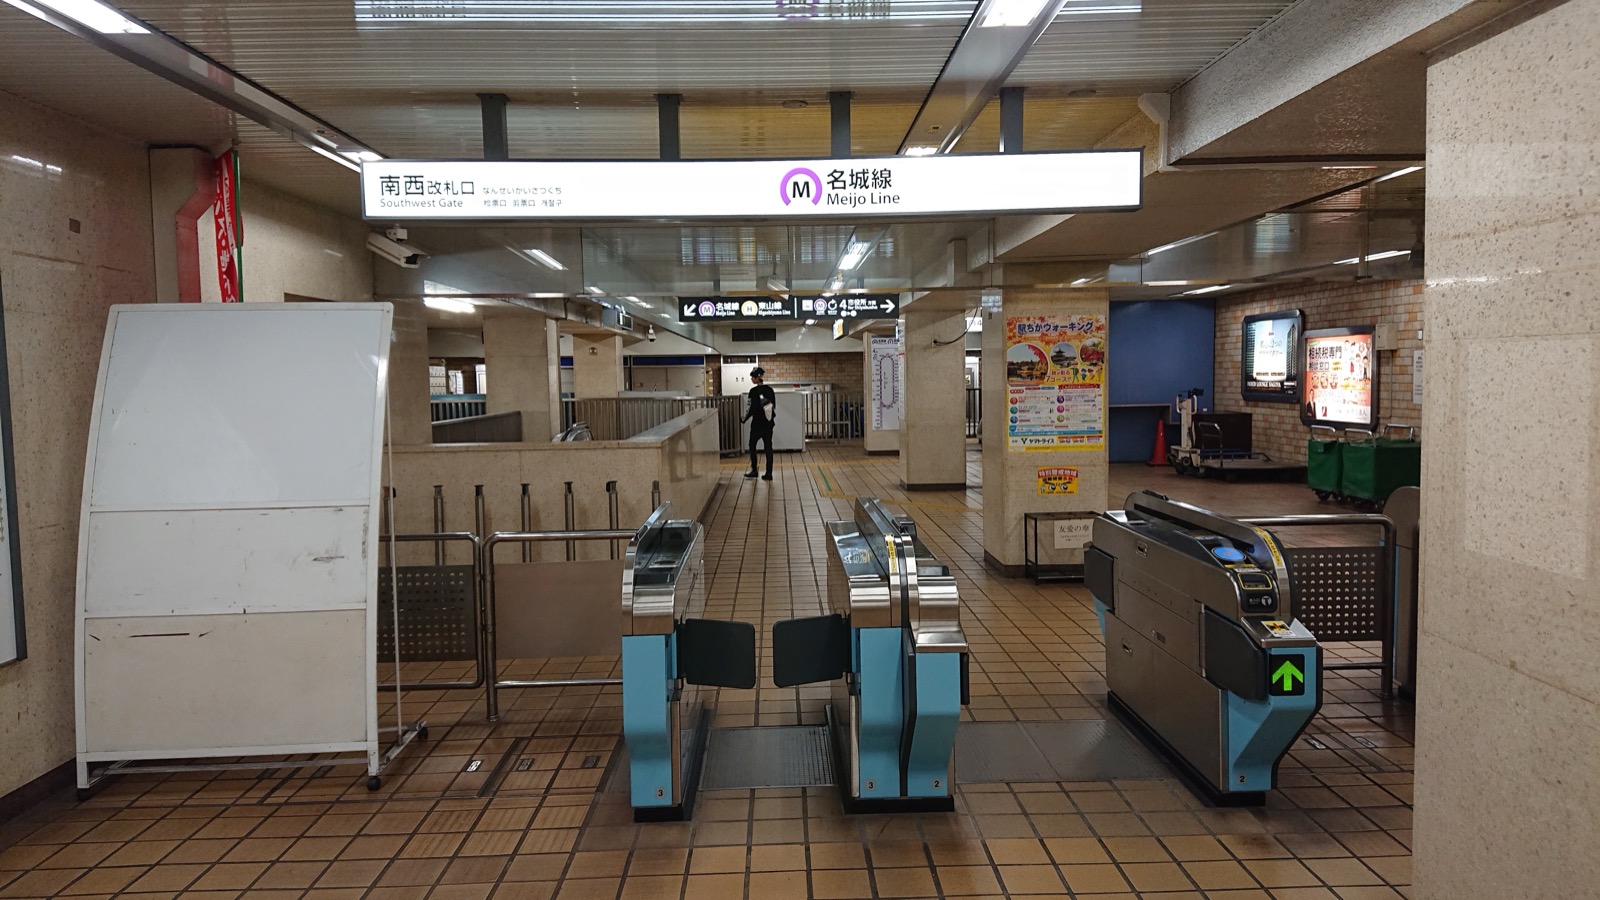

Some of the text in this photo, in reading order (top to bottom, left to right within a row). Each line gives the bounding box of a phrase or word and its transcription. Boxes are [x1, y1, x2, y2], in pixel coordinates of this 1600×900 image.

[826, 168, 892, 190] 名城線
[379, 175, 475, 196] 南西改札口
[482, 187, 562, 195] なんせいかいさつくち
[792, 181, 811, 198] M
[380, 198, 464, 208] Southwest Gate
[826, 192, 900, 208] Meijo Line
[716, 302, 740, 311] 名城線
[758, 301, 783, 310] 東山線
[839, 299, 847, 310] 4
[1017, 321, 1095, 335] 駅ちかウォーキング
[1308, 346, 1342, 360] 相続税専門
[1308, 361, 1330, 371] 相談窓口
[1038, 468, 1078, 478] 特別警戒地域
